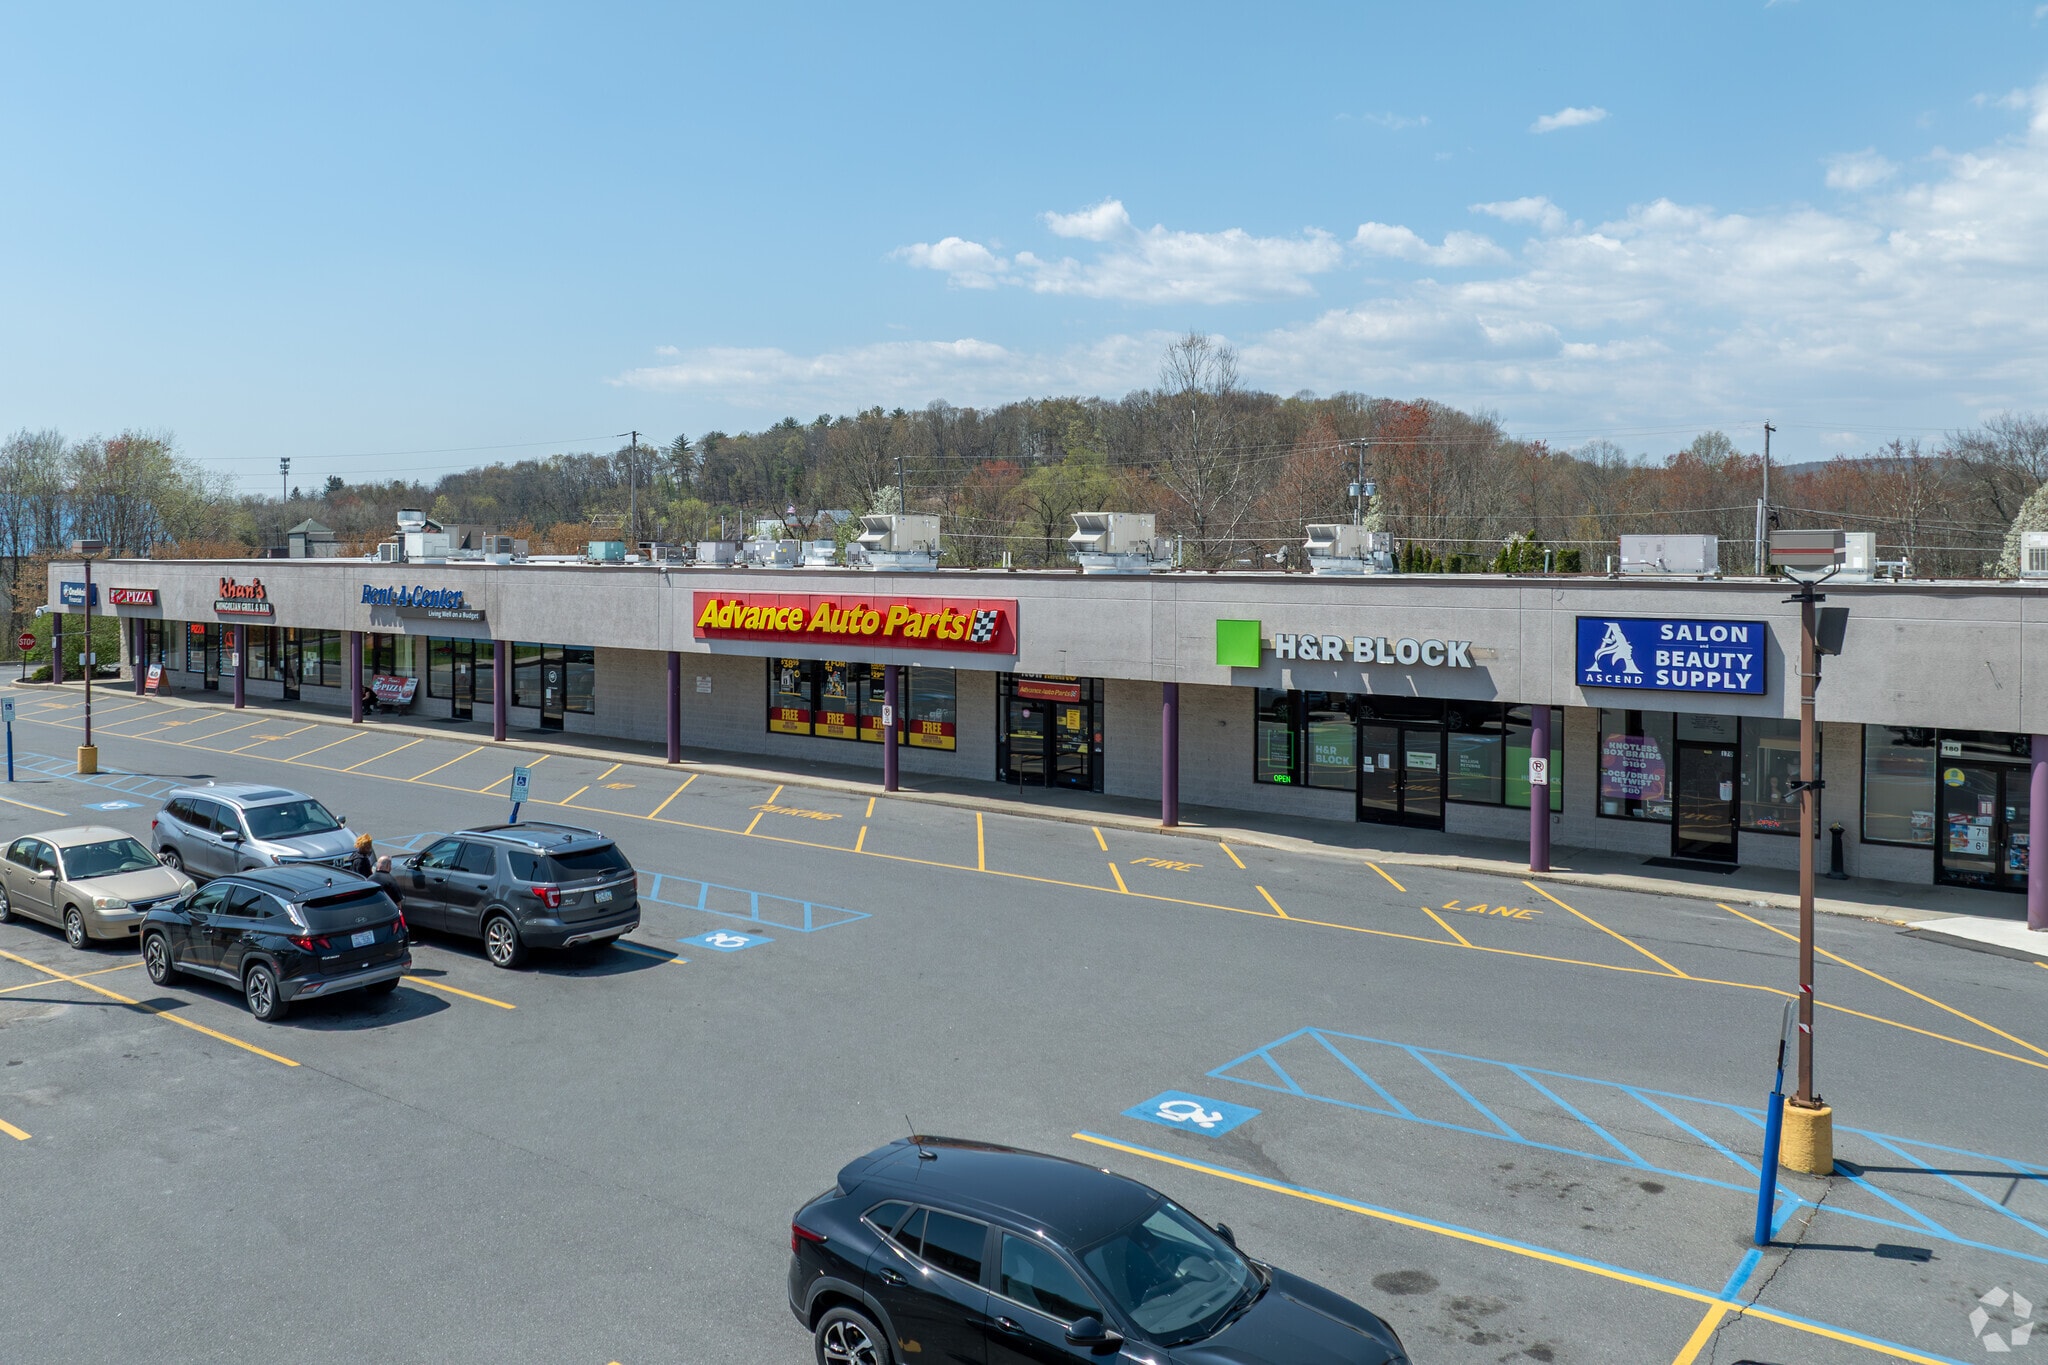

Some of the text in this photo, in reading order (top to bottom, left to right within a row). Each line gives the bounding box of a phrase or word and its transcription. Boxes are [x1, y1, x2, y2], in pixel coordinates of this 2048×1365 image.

[126, 591, 153, 603] PIZZA
[259, 603, 270, 612] BAR
[428, 610, 441, 619] Living
[463, 612, 479, 620] Budget
[697, 599, 966, 641] Advance Auto Parts
[191, 624, 205, 634] PIZZA
[1660, 624, 1748, 643] SALON
[19, 638, 35, 646] STOP
[1275, 633, 1473, 669] H&R BLOCK
[1656, 650, 1753, 670] BEAUTY
[1586, 673, 1643, 684] ASCEND
[1656, 670, 1753, 690] SUPPLY
[381, 684, 402, 692] PIZZA
[781, 709, 798, 721] FREE
[827, 713, 845, 725] FREE
[922, 721, 941, 735] FREE
[1315, 745, 1337, 755] H&R
[1609, 742, 1658, 753] KNOTLESS
[1315, 754, 1350, 766] BLOCK
[1603, 748, 1661, 760] BOX BRAIDS
[1273, 774, 1291, 784] OPEN
[1611, 776, 1652, 786] RETWIST
[749, 804, 843, 821] PARKING
[1757, 819, 1780, 827] OPEN
[1129, 857, 1204, 872] FIRE
[1442, 900, 1544, 920] LANE
